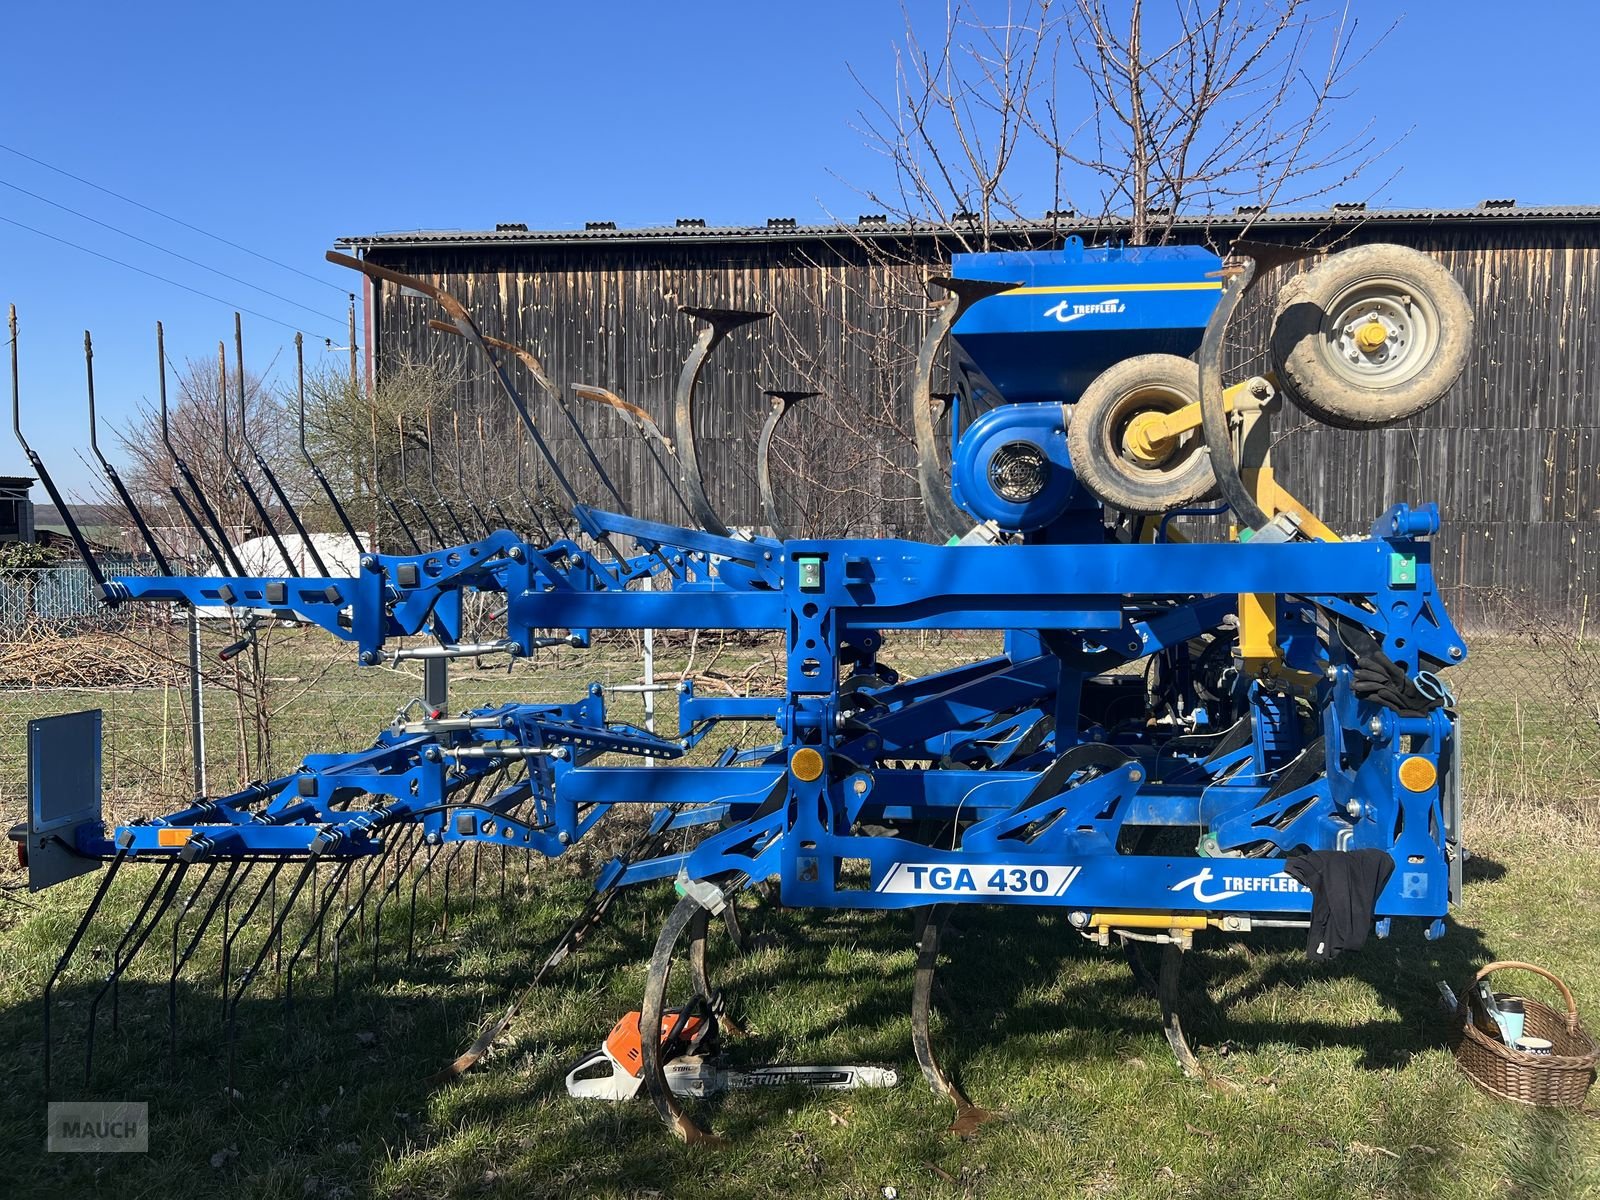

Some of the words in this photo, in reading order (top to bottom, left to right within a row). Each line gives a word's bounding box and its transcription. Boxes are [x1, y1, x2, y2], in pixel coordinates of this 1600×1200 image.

[1073, 304, 1117, 314] TREFFLER
[907, 866, 977, 891] TGA
[987, 868, 1049, 893] 430
[1222, 876, 1299, 893] TREFFLER
[672, 1065, 693, 1073] STIHL
